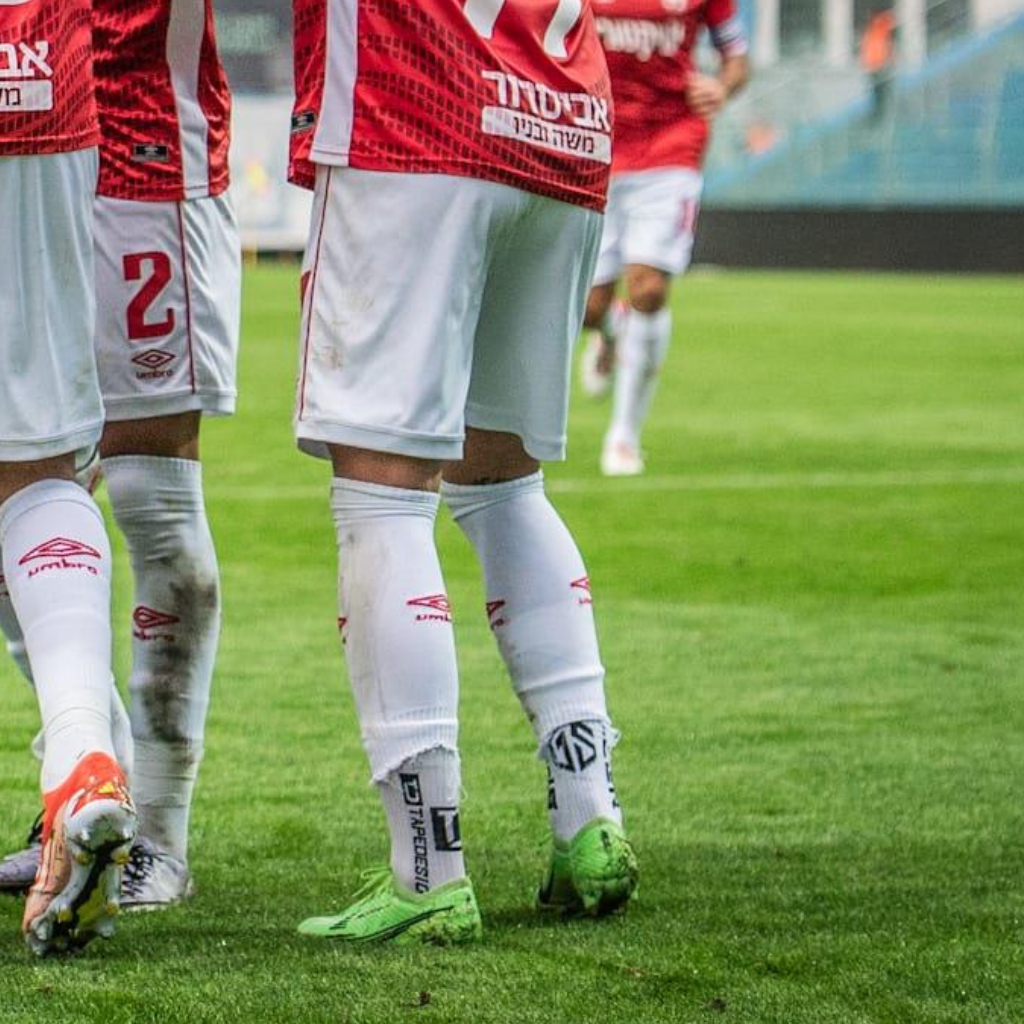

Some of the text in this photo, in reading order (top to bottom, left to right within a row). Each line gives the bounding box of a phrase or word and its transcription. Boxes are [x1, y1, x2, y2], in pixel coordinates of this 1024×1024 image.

[482, 69, 611, 132] אביסרור
[514, 116, 594, 154] משה ובניו
[123, 251, 175, 339] 2
[27, 558, 98, 578] umbro
